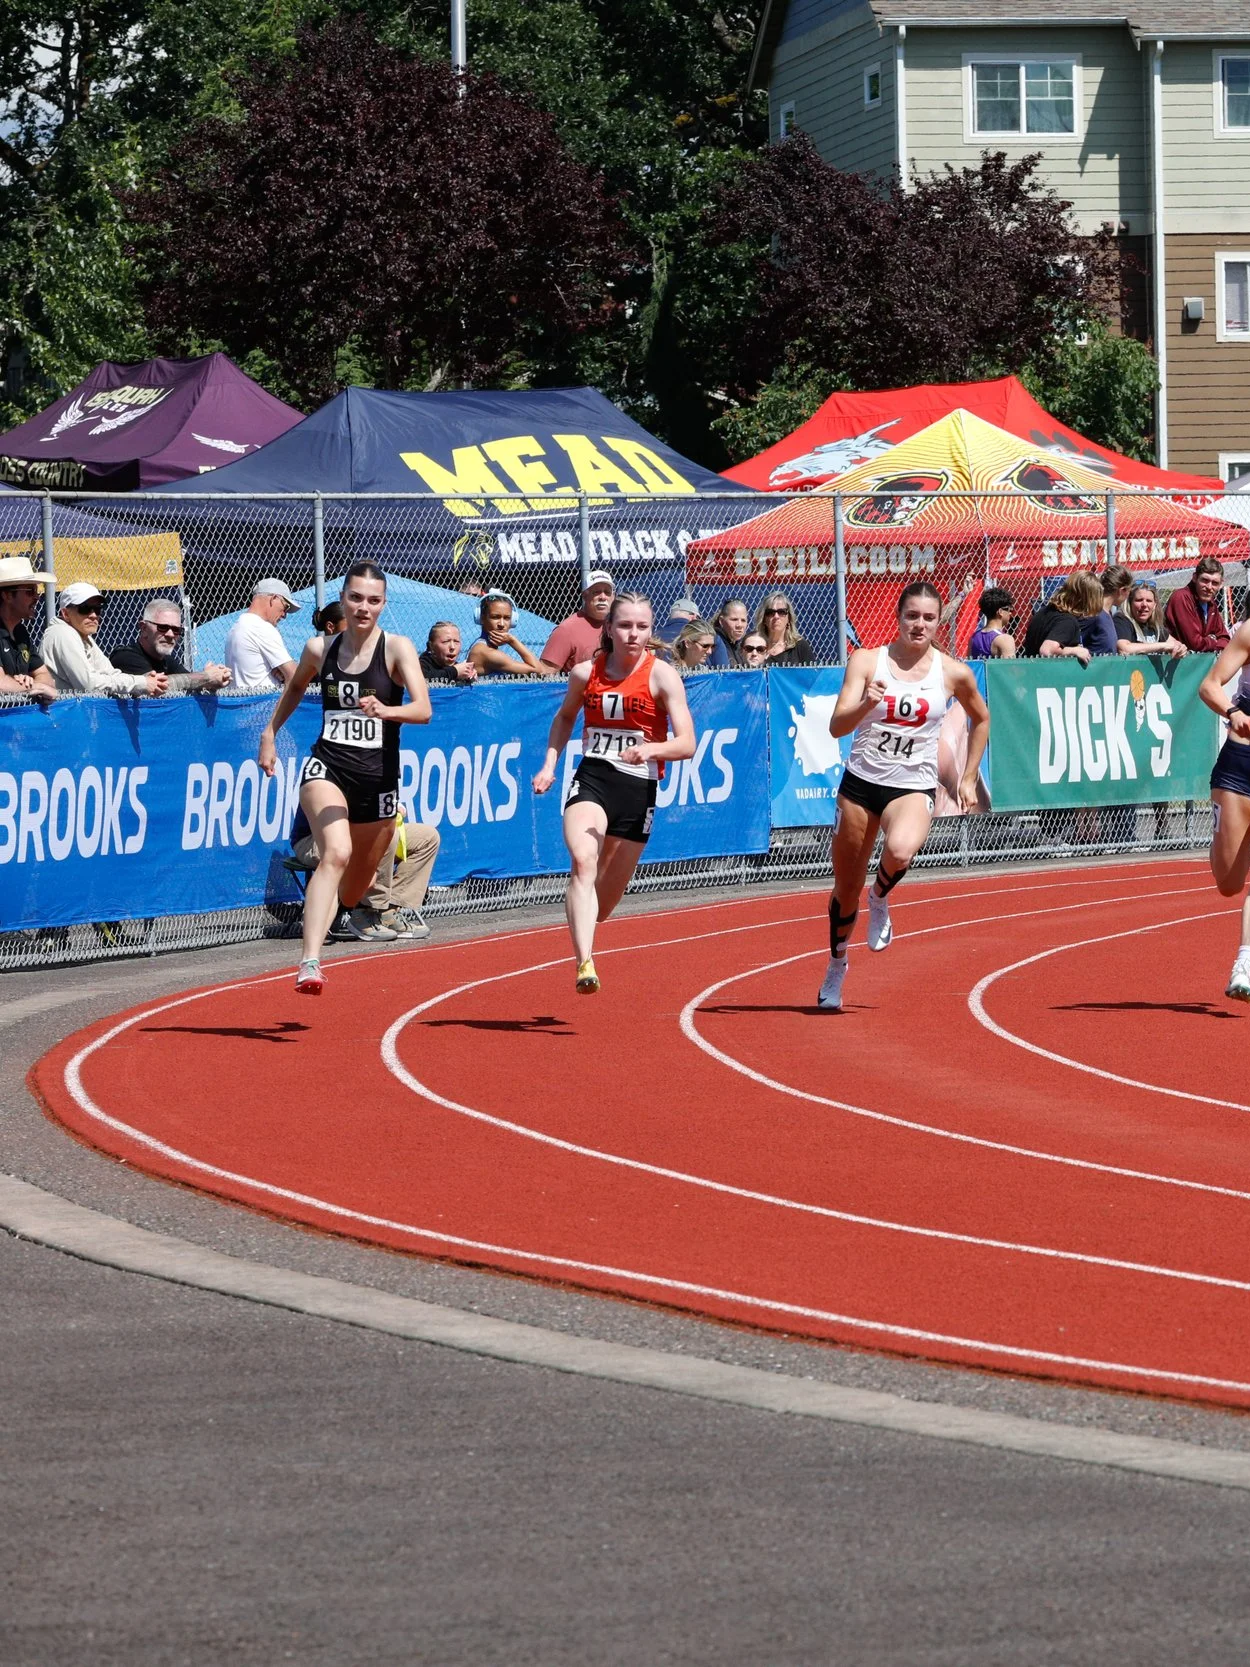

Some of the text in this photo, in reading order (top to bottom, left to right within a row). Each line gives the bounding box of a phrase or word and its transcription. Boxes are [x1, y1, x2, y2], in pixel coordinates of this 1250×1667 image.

[0, 456, 87, 488] OSS COUNTRY
[399, 434, 702, 517] MEAD
[500, 530, 577, 563] MEAD
[583, 529, 676, 561] TRACK
[343, 683, 356, 706] 8
[607, 694, 619, 719] 7
[899, 693, 912, 717] 6
[330, 718, 376, 741] 2190
[877, 731, 915, 759] 214
[1036, 677, 1173, 784] DICK'S
[397, 742, 521, 828] ROOKS
[0, 765, 148, 864] BROOKS
[182, 756, 308, 850] BROOK
[383, 793, 394, 815] 8
